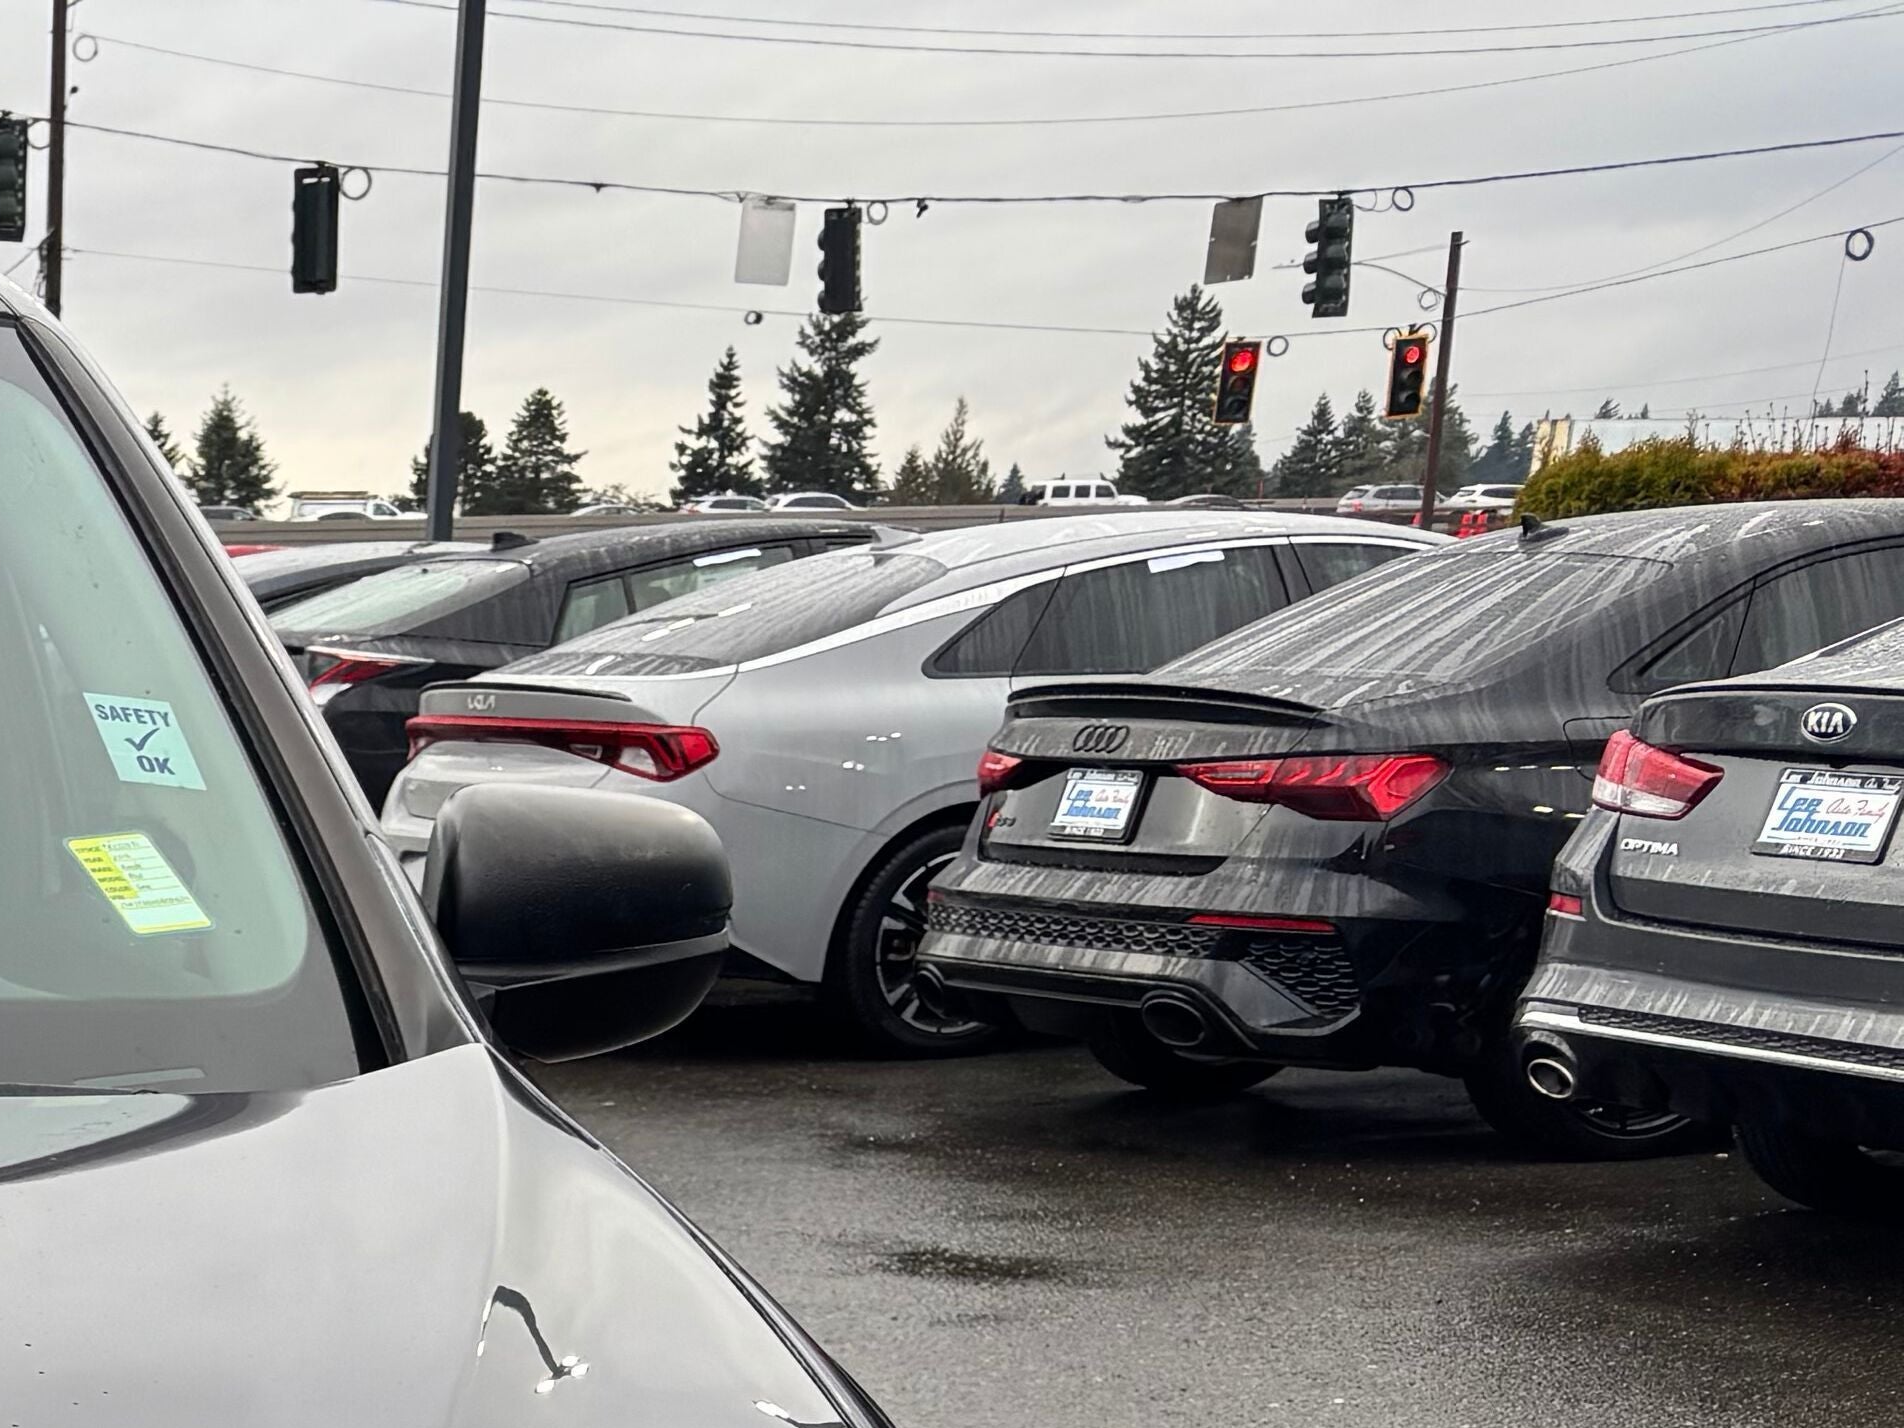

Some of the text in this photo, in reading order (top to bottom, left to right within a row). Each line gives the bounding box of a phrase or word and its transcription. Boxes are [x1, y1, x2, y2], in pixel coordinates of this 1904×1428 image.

[94, 703, 171, 728] SAFETY
[1807, 711, 1844, 733] KIA
[136, 754, 176, 776] OK
[1620, 838, 1679, 856] OPTIMA
